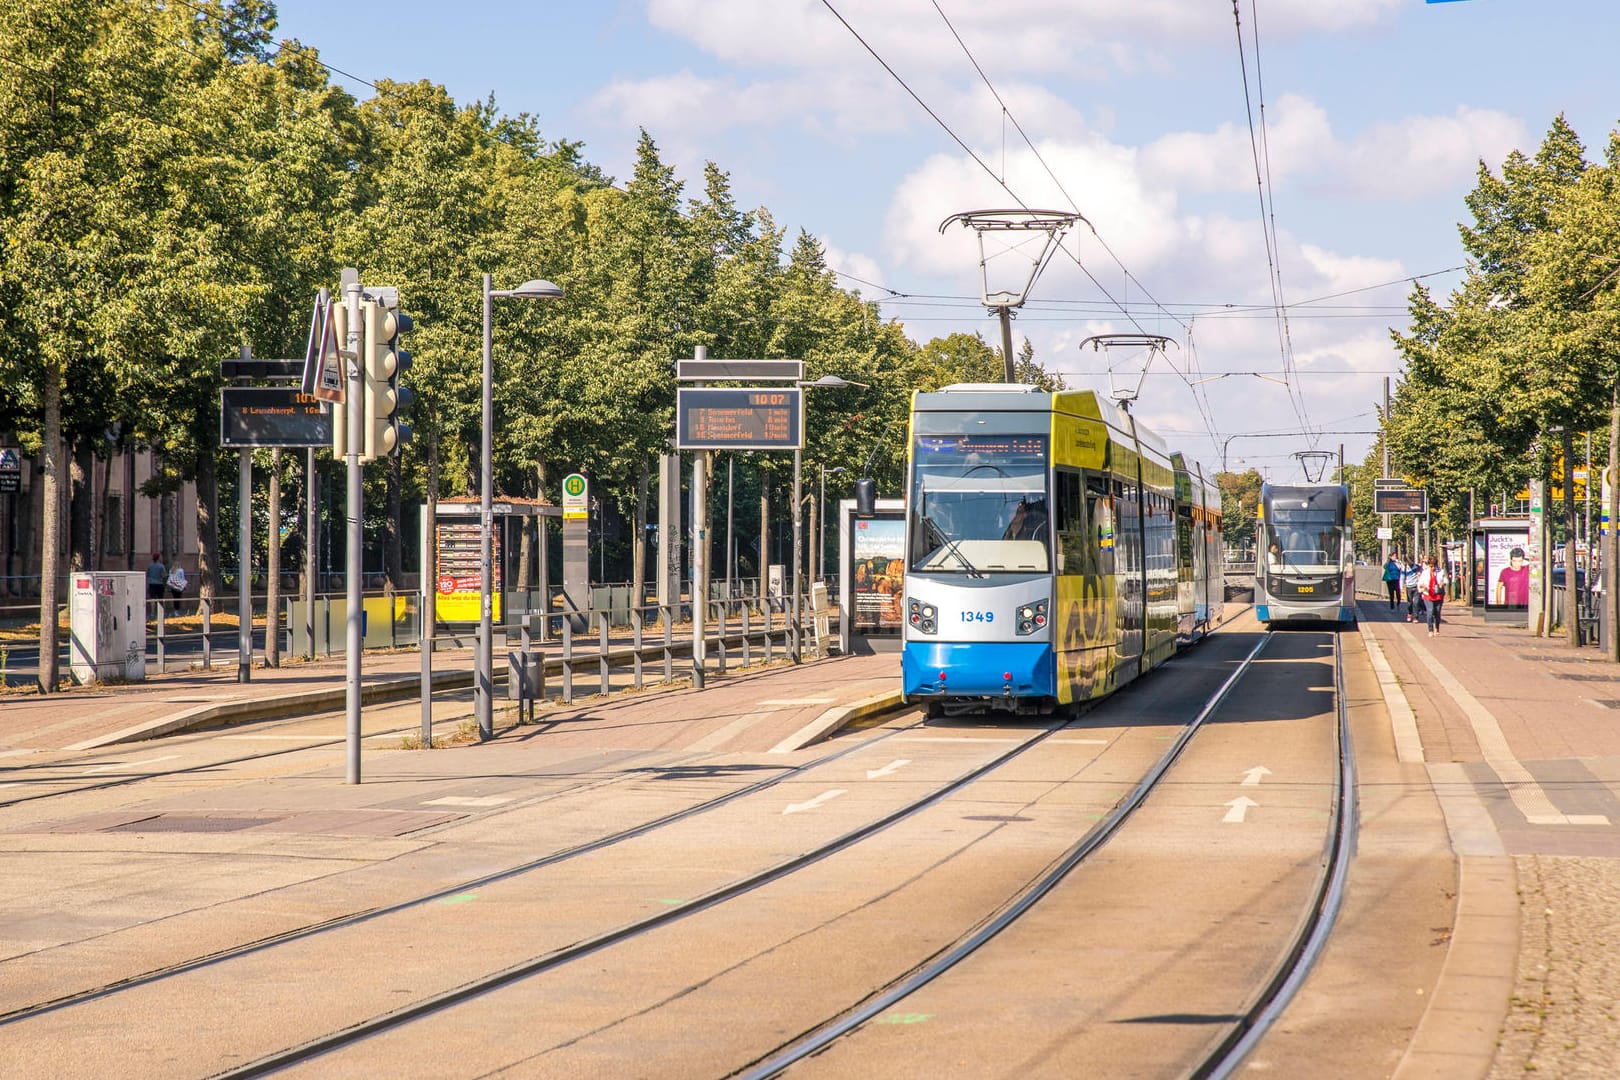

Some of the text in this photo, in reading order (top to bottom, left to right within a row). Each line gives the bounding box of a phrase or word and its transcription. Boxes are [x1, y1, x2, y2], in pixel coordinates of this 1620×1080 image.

[295, 393, 308, 403] 10
[754, 394, 785, 405] 10 07
[707, 408, 753, 416] Sommerfeld
[961, 611, 994, 622] 1349
